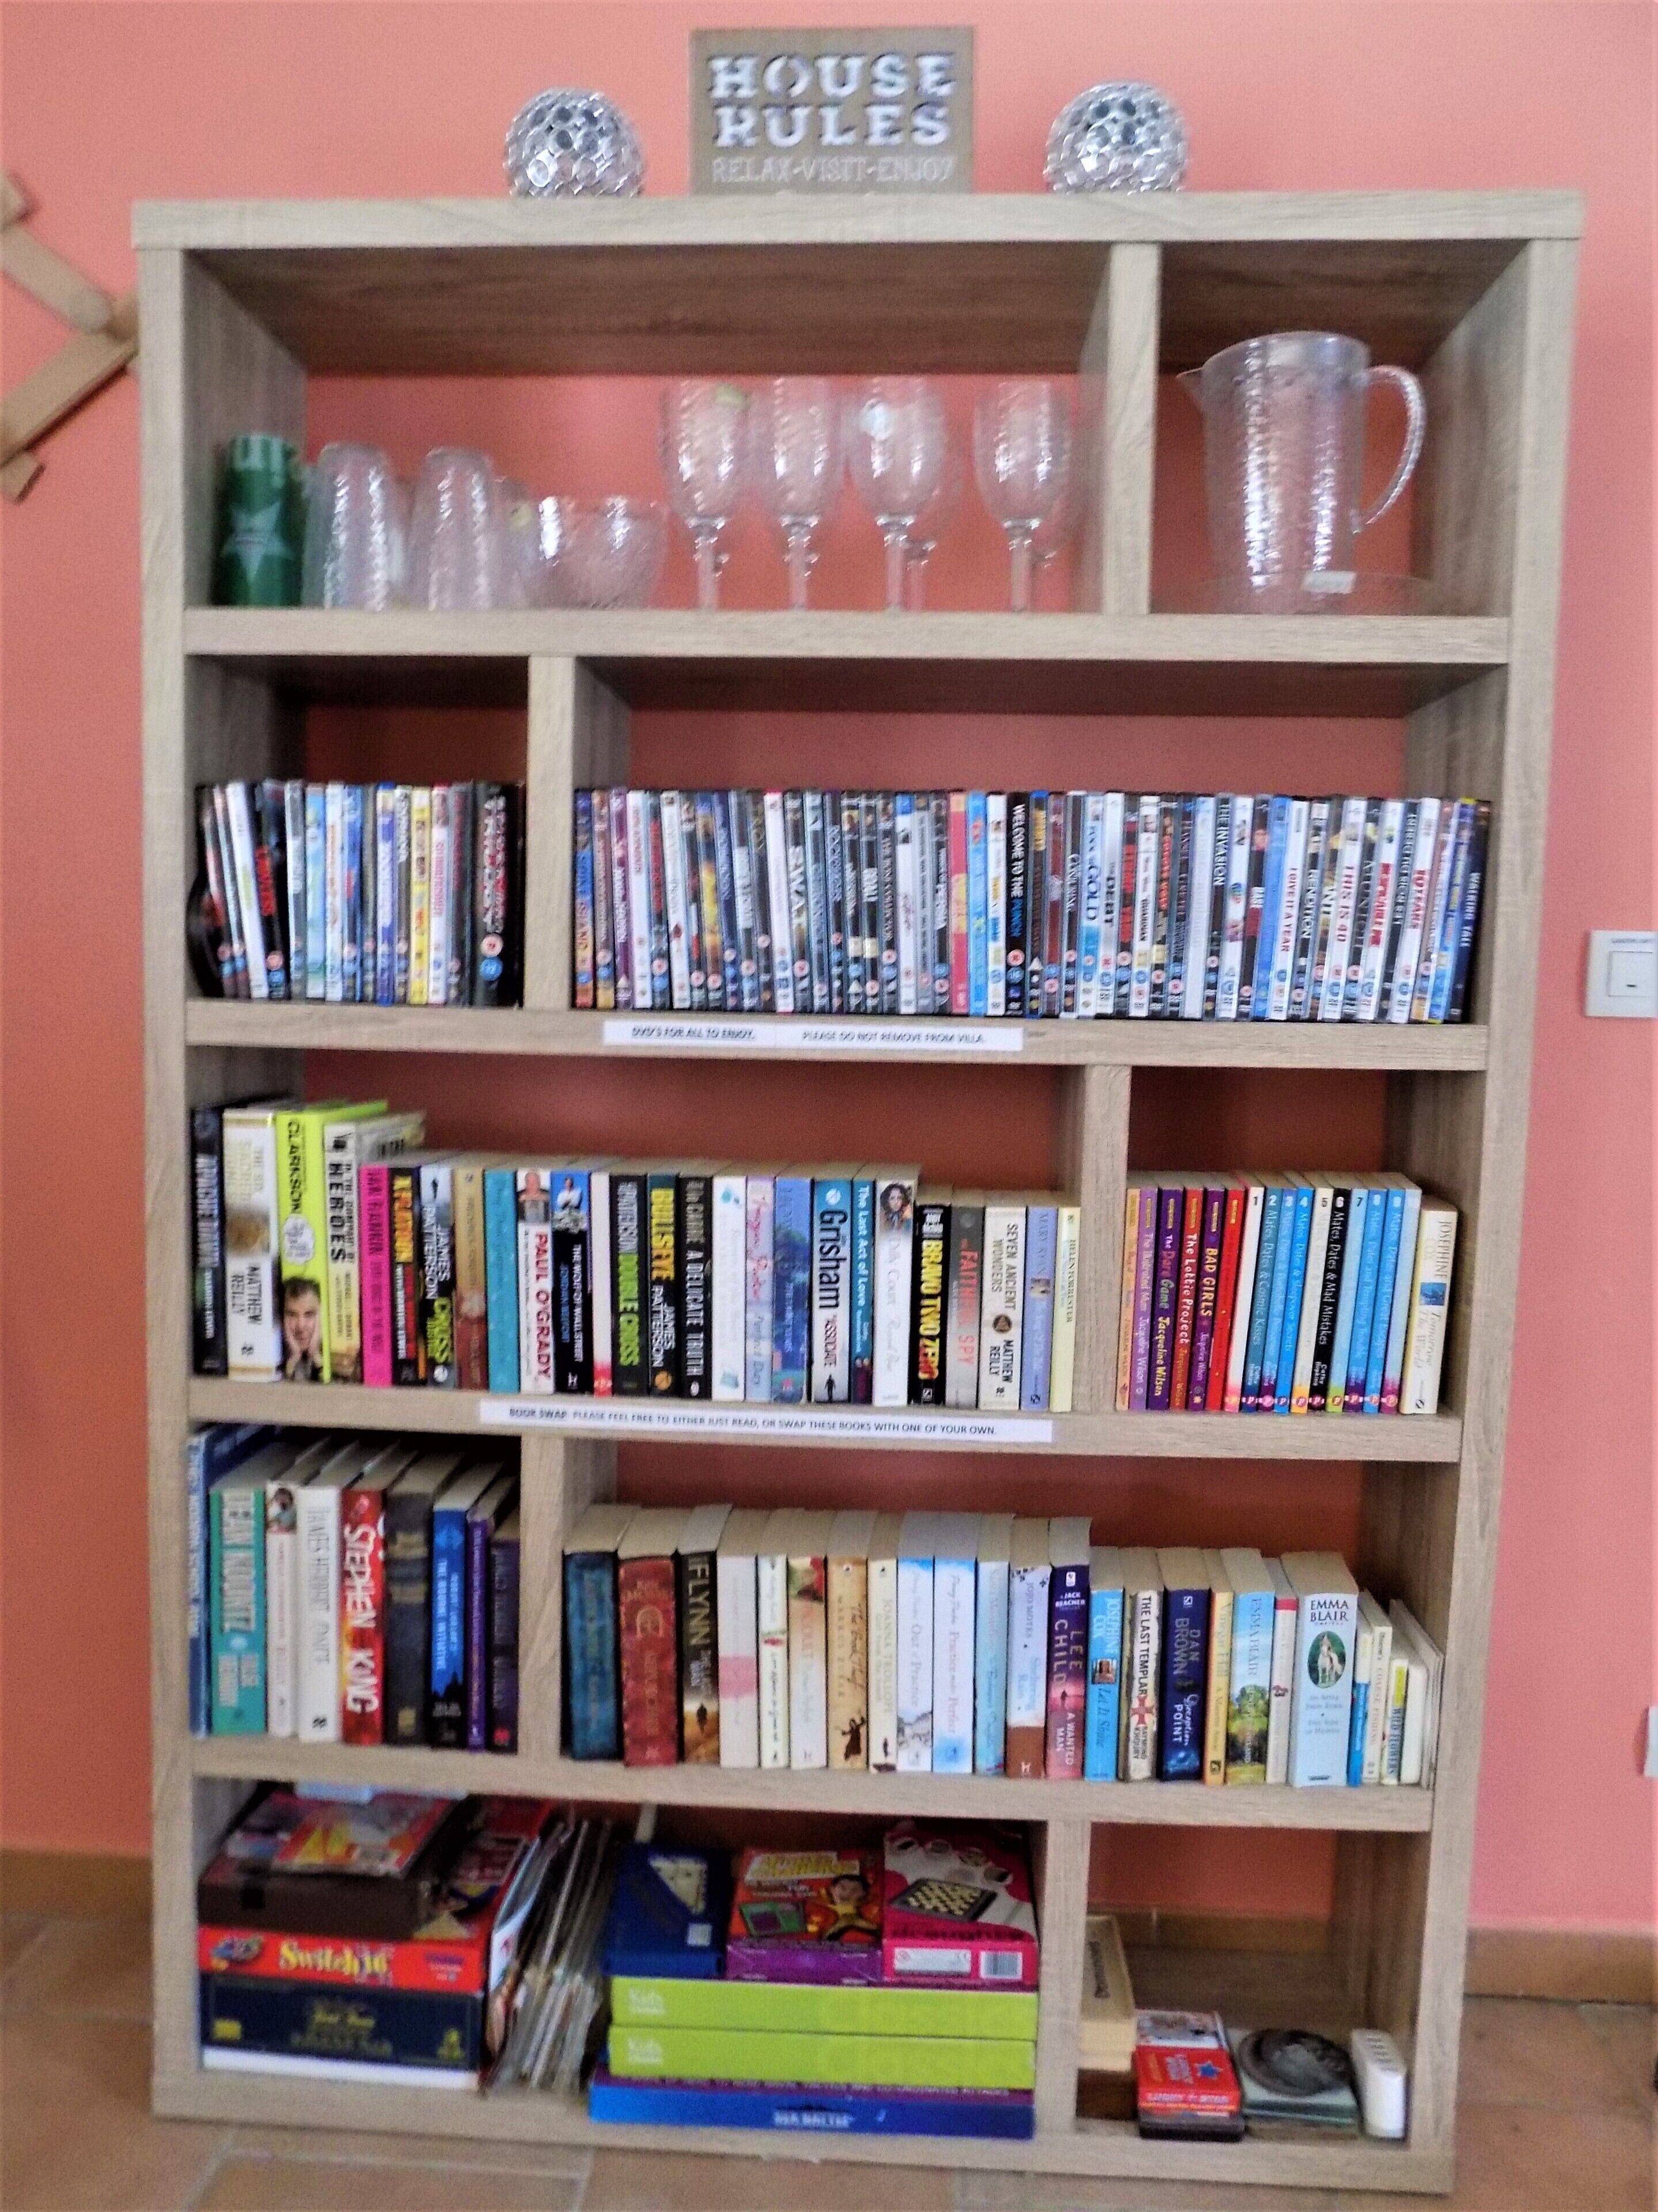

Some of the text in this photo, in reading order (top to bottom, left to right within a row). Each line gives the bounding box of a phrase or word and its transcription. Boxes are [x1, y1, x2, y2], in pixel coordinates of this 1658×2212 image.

[708, 52, 957, 99] HOUSE
[713, 100, 953, 147] RULES
[1010, 803, 1025, 937] WELCOME TO THE PUNCH
[1213, 804, 1230, 886] THE INVASION
[1280, 874, 1296, 953] GIVE YEAR
[1301, 869, 1318, 939] RENDITION
[1337, 866, 1355, 942] THIS IS 40
[1460, 872, 1480, 948] WALKING TALL
[631, 1027, 720, 1039] DVD'S FOR ALL TO
[802, 1032, 954, 1043] PLEASE DO NOT REMOVE FROM
[287, 1122, 302, 1214] CLARKSON
[328, 1162, 346, 1263] HEROES
[345, 1200, 355, 1248] COMPANY
[617, 1189, 638, 1254] PATTERSON
[1253, 1196, 1258, 1206] 1
[1268, 1195, 1277, 1206] 2
[1300, 1195, 1308, 1207] 4
[1321, 1197, 1329, 1207] 5
[1335, 1196, 1344, 1208] 6
[1356, 1197, 1363, 1207] 7
[423, 1206, 439, 1300] PATTERSON
[435, 1225, 451, 1282] JAMES
[651, 1188, 675, 1281] BULLSEYE
[818, 1210, 849, 1308] Grisham
[858, 1187, 870, 1306] The Last Act of Love
[1434, 1220, 1453, 1278] JOSEPHINE
[230, 1274, 246, 1316] REILLY
[244, 1266, 263, 1324] MATTHEW
[887, 1270, 902, 1305] Court
[991, 1239, 1004, 1293] WONDERS
[1003, 1223, 1019, 1310] SEVEN ANCIENT
[1067, 1239, 1077, 1323] HELEN FORRESTER
[1159, 1234, 1177, 1309] The Dare Game
[1178, 1233, 1197, 1344] The Lottie Project
[1200, 1248, 1217, 1317] BAD GIRLS
[1253, 1209, 1277, 1346] Mates, Dates Cosmic Kisses
[1319, 1211, 1345, 1345] Mates, Dates & Mad Mistakes
[535, 1233, 551, 1379] PAUL O'GRADY
[572, 1244, 583, 1362] THE STREET
[618, 1254, 639, 1366] DOUBLE CROSS
[651, 1285, 665, 1368] PATTERSON
[663, 1304, 676, 1350] JAMES
[686, 1249, 704, 1376] A DELICATE TRUTH
[917, 1239, 943, 1381] BRAVO TWO ZERO
[824, 1318, 837, 1369] ASSOCIATE
[958, 1335, 976, 1365] SPY
[989, 1346, 1001, 1376] REILLY
[1000, 1340, 1014, 1383] MATTHEW
[1134, 1317, 1148, 1383] Jacqueline Wilson
[1154, 1316, 1170, 1396] Jacqueline Wilson
[1196, 1332, 1209, 1381] Jacqueline Wilson
[1413, 1310, 1430, 1369] The World
[1426, 1311, 1441, 1366] Tomorrow
[1319, 1364, 1327, 1384] Cathy
[510, 1409, 996, 1435] BOOK PLEASE FEEL FREE TO EITHER JUST READ, OR SWAP THESE BOOKS WITH ONE OF YOUR OWN.
[344, 1523, 379, 1714] STEPHEN KING
[688, 1563, 710, 1647] FLYNN
[1025, 1582, 1034, 1639] JOJO MOYES
[1055, 1599, 1085, 1607] REACHER
[1105, 1598, 1121, 1653] JOSEPHINE
[1310, 1599, 1349, 1611] EMMA
[1310, 1611, 1349, 1622] BLAIR
[883, 1598, 894, 1713] JOANNA TROLLOPE
[911, 1623, 924, 1706] Out Practice
[948, 1631, 959, 1672] Practice
[1053, 1619, 1068, 1683] CHILD
[1069, 1630, 1083, 1670] LEE
[1138, 1596, 1152, 1695] THE LAST TEMPLAR
[1173, 1616, 1190, 1675] BROWN
[1189, 1629, 1201, 1661] DAN
[1247, 1597, 1262, 1676] EMMA BLAIR
[1055, 1728, 1065, 1752] MAN
[1065, 1712, 1075, 1766] A WANTED
[1095, 1687, 1107, 1747] Let Shine
[1132, 1728, 1140, 1760] KHOURY
[1172, 1704, 1184, 1744] POINT
[1179, 1694, 1198, 1747] Deception
[1369, 1707, 1380, 1745] FISHING
[1387, 1707, 1403, 1775] WILD FLOWERS
